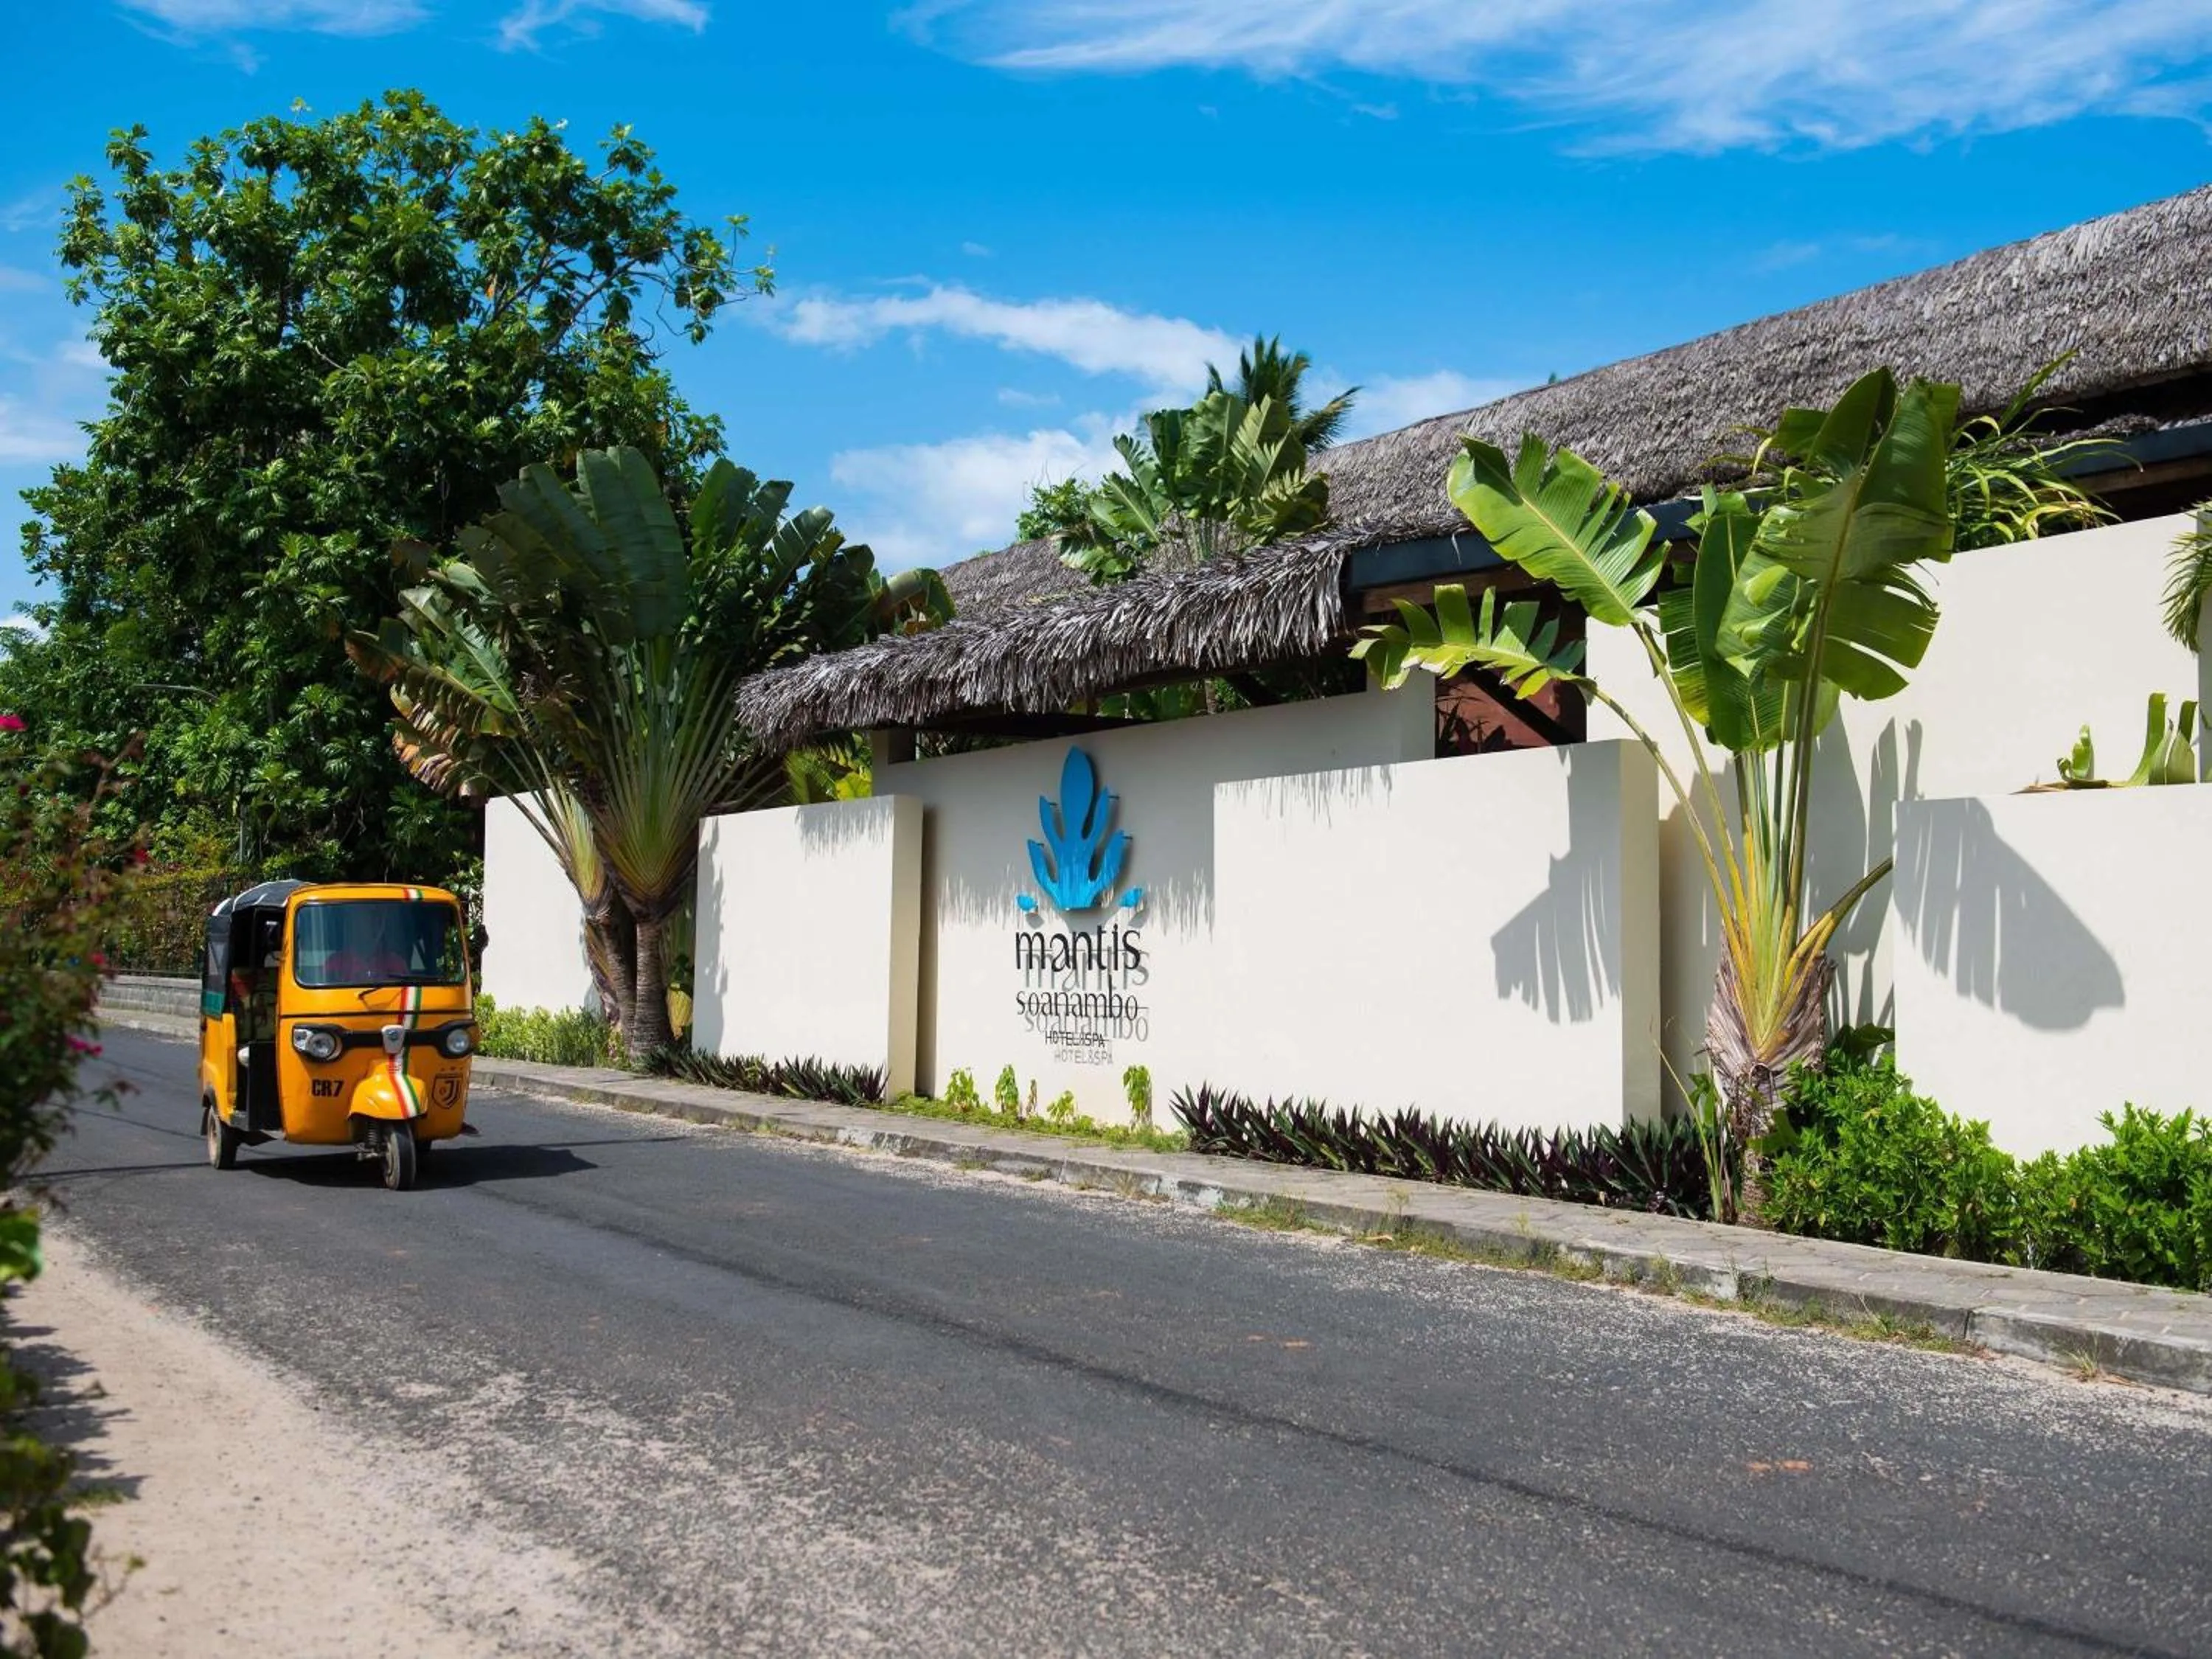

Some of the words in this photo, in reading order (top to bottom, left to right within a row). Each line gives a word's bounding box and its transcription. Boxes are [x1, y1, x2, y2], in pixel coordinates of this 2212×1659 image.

[1016, 924, 1141, 972] mantis
[1016, 975, 1138, 1021] soanambo
[312, 1079, 344, 1097] CR7
